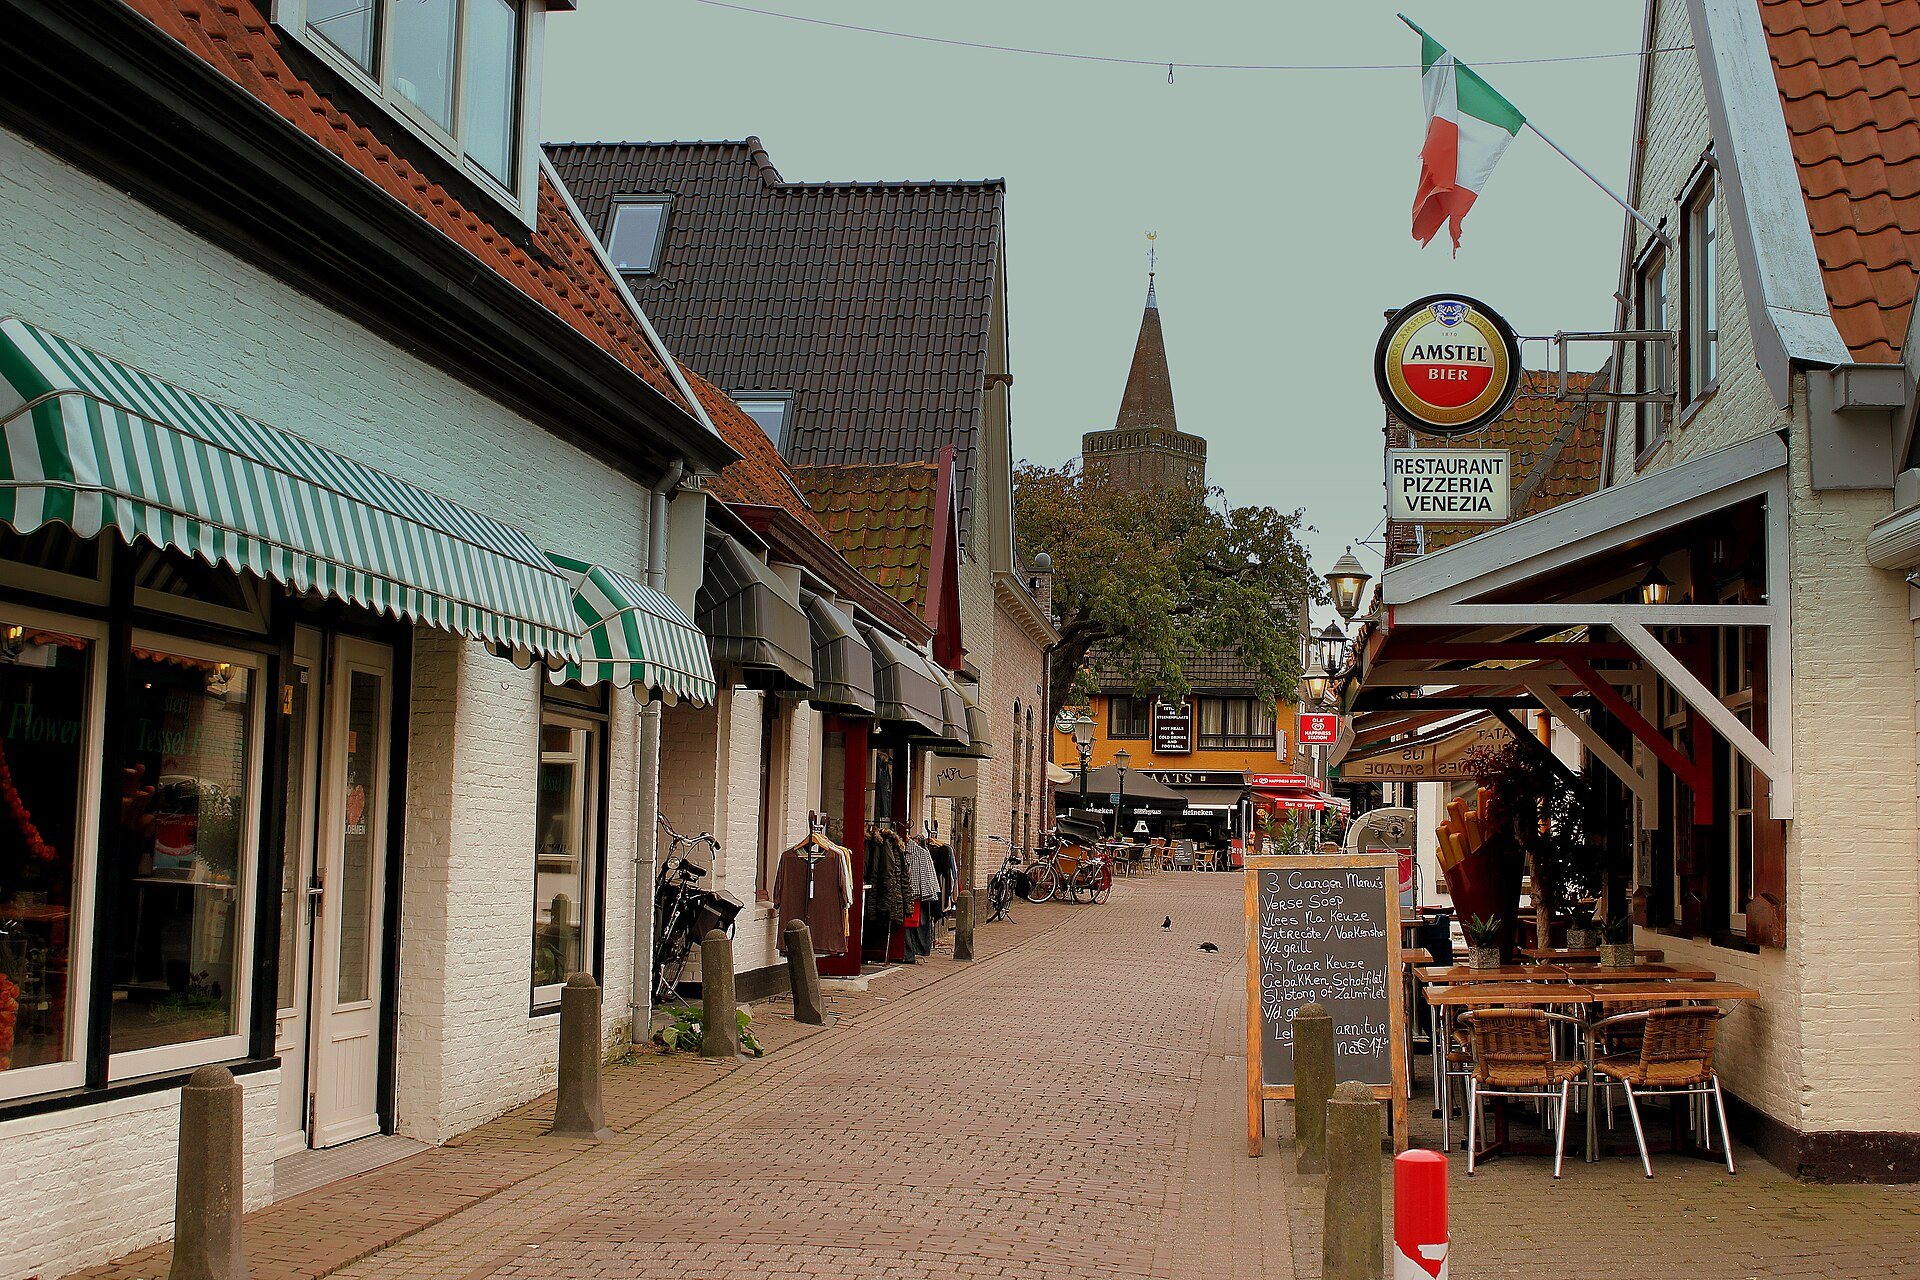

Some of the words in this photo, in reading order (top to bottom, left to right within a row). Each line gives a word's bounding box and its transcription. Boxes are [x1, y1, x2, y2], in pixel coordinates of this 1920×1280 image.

[1411, 344, 1487, 362] AMSTEL
[1428, 368, 1468, 381] BIER
[1394, 459, 1503, 474] RESTAURANT
[1403, 477, 1493, 493] PIZZERIA
[1405, 496, 1492, 512] VENEZIA
[1266, 872, 1281, 894] 3
[1345, 872, 1384, 889] Menu's
[1261, 894, 1304, 912] Verse
[1308, 894, 1344, 910] Soep
[1261, 912, 1299, 928] Vlees
[1330, 909, 1370, 923] Keuze
[1284, 940, 1312, 959] grill
[1261, 955, 1282, 972] Vis
[1326, 953, 1365, 970] Keuze
[1263, 988, 1316, 1004] Slibtong
[1320, 985, 1333, 1000] of
[1334, 985, 1387, 1000] Zalmfilet
